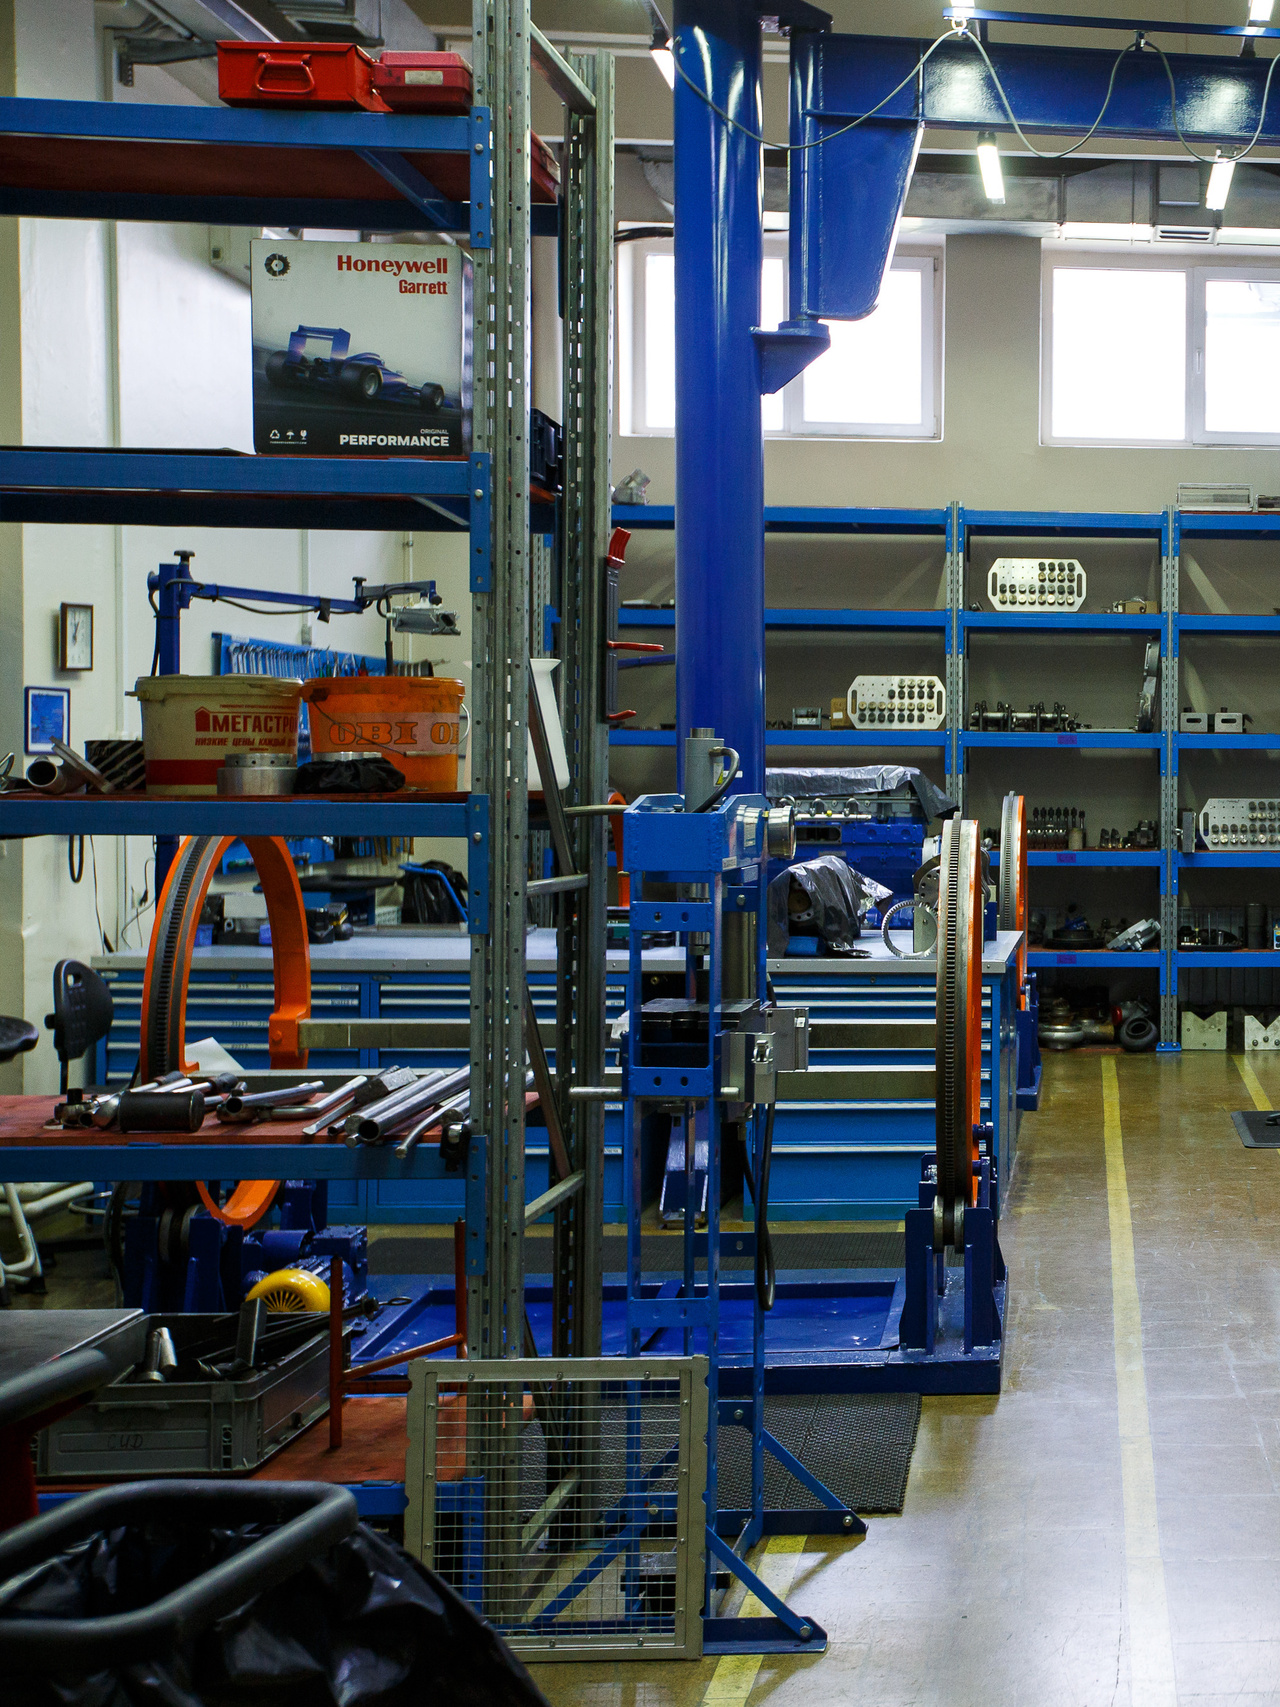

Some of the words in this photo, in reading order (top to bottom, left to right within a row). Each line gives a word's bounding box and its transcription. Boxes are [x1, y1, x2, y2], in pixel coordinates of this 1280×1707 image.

[337, 255, 448, 276] Honeywell
[399, 279, 448, 294] Garrett
[339, 434, 450, 447] PERFORMANCE
[329, 722, 418, 745] OBI
[195, 738, 228, 746] НИЗКИЕ
[232, 738, 255, 747] ЦЕНЫ
